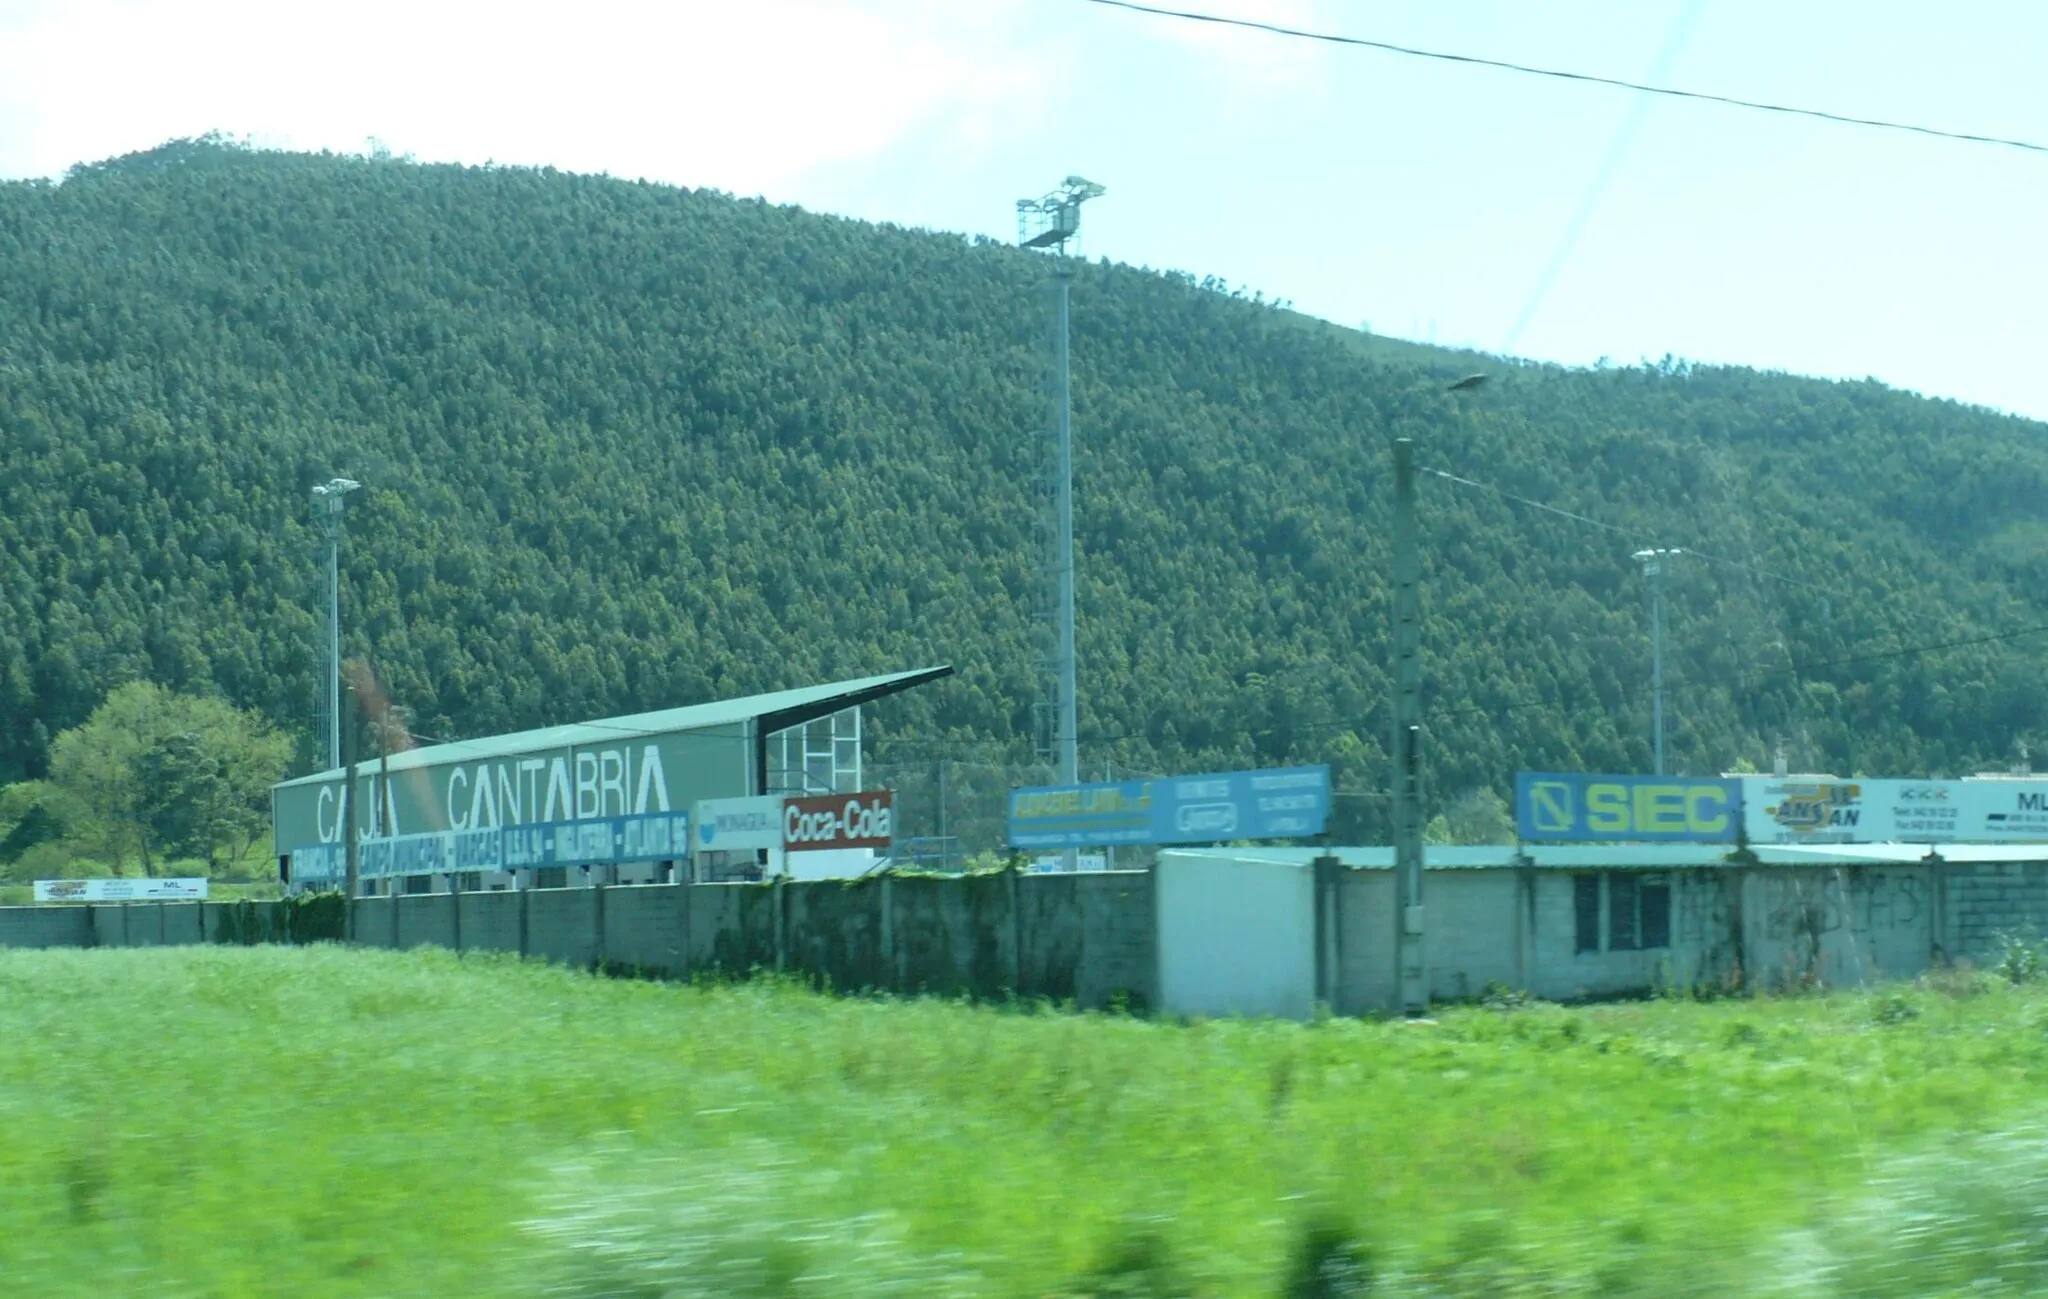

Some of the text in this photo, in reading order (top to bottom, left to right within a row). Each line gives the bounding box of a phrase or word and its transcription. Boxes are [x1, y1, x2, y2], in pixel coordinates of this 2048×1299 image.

[448, 745, 671, 831] CANTABRIA
[1586, 783, 1729, 833] SIEC
[785, 799, 891, 843] Coca-Cola
